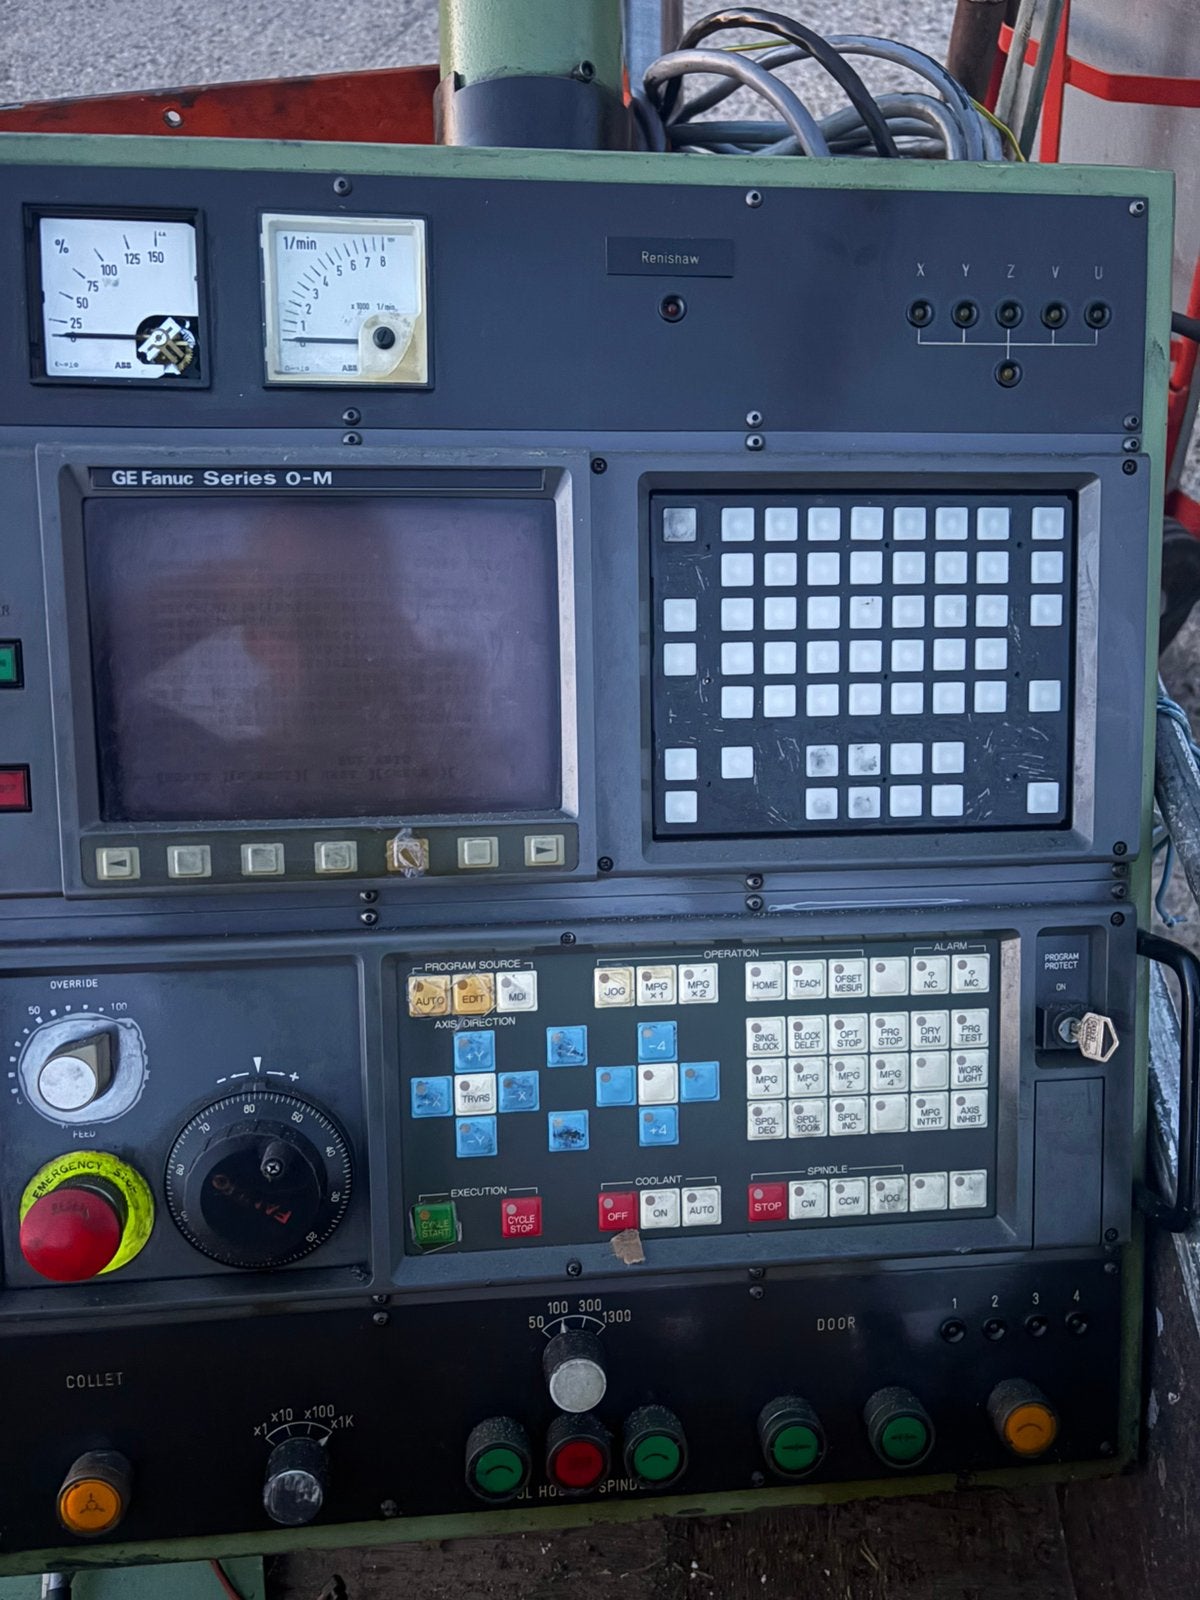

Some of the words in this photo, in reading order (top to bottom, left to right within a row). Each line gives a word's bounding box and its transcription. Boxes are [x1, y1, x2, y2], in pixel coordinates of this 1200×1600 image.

[55, 239, 69, 254] %
[283, 236, 318, 251] 1/min
[124, 252, 141, 266] 125
[147, 251, 165, 264] 150
[380, 257, 387, 267] 8
[641, 250, 701, 265] Renishaw
[350, 260, 357, 271] 6
[365, 257, 371, 269] 7
[100, 263, 118, 277] 100
[336, 265, 343, 276] 5
[916, 264, 925, 277] X
[962, 264, 970, 278] Y
[1007, 265, 1015, 278] Z
[1052, 266, 1060, 279] V
[1095, 267, 1103, 280] U
[86, 280, 99, 293] 75
[322, 277, 329, 288] 4
[312, 289, 320, 300] 3
[76, 296, 88, 310] 50
[305, 304, 312, 315] 2
[70, 316, 83, 330] 25
[301, 321, 306, 332] 1
[112, 470, 138, 486] GE
[141, 470, 194, 486] Fanuc
[203, 470, 277, 486] Series
[934, 942, 968, 951] ALARM
[704, 949, 759, 959] OPERATION
[1045, 952, 1079, 961] PROGRAM
[425, 962, 476, 971] PROGRAM
[479, 960, 521, 970] SOURCE
[1045, 961, 1078, 970] PROTECT
[835, 974, 861, 983] OFSET
[964, 978, 979, 987] MC
[50, 979, 98, 990] OVERRIDE
[645, 982, 668, 991] MPG
[688, 980, 709, 989] MPG
[752, 980, 778, 990] HOME
[794, 979, 821, 989] TEACH
[835, 983, 863, 993] MESUR
[923, 979, 938, 989] NC
[1056, 983, 1066, 991] ON
[508, 992, 526, 1002] MDI
[604, 987, 625, 997] JOG
[416, 996, 444, 1006] AUTO
[462, 994, 484, 1004] EDIT
[28, 1006, 41, 1015] 50
[111, 1002, 128, 1012] 100
[435, 1019, 457, 1030] AXIS
[463, 1017, 516, 1028] DIRECTION
[840, 1029, 858, 1039] OPT
[880, 1028, 899, 1037] PRG
[920, 1026, 941, 1035] DRY
[962, 1024, 981, 1034] PRG
[754, 1033, 778, 1042] SINGL
[794, 1031, 821, 1041] BLOCK
[878, 1036, 903, 1046] STOP
[921, 1034, 941, 1044] RUN
[959, 1033, 982, 1042] TEST
[649, 1041, 666, 1051] -4
[752, 1041, 780, 1052] BLOCK
[794, 1040, 820, 1050] DELET
[837, 1038, 862, 1048] STOP
[466, 1051, 484, 1061] +Y
[880, 1069, 902, 1079] MPG
[958, 1065, 983, 1075] WORK
[755, 1075, 777, 1085] MPG
[797, 1073, 819, 1083] MPG
[838, 1071, 860, 1081] MPG
[957, 1074, 983, 1083] LIGHT
[763, 1084, 770, 1092] X
[805, 1082, 812, 1091] Y
[846, 1080, 853, 1089] Z
[887, 1079, 895, 1087] 4
[461, 1093, 490, 1104] TRVRS
[920, 1108, 941, 1117] MPG
[960, 1106, 980, 1115] AXIS
[755, 1116, 779, 1126] SPDL
[796, 1114, 820, 1124] SPDL
[837, 1112, 862, 1122] SPDL
[917, 1116, 943, 1126] INTRT
[956, 1114, 982, 1124] INHBT
[198, 1123, 211, 1135] 70
[649, 1125, 667, 1135] +4
[757, 1125, 776, 1135] DEC
[797, 1123, 821, 1132] 100%
[841, 1121, 857, 1131] INC
[325, 1146, 336, 1158] 40
[807, 1165, 848, 1175] SPINDLE
[32, 1161, 103, 1199] EMERGENCY
[635, 1175, 682, 1185] COOLANT
[331, 1191, 341, 1203] 30
[450, 1186, 507, 1198] EXECUTION
[838, 1196, 860, 1206] CCW
[880, 1193, 900, 1203] JOG
[754, 1202, 782, 1212] STOP
[801, 1199, 816, 1208] CW
[653, 1208, 667, 1218] ON
[690, 1205, 714, 1216] AUTO
[508, 1215, 535, 1225] CYCLE
[607, 1211, 629, 1221] OFF
[421, 1219, 449, 1229] CYCLE
[510, 1224, 533, 1233] STOP
[305, 1231, 318, 1243] 20
[1033, 1293, 1039, 1305] 3
[1073, 1290, 1080, 1302] 4
[579, 1299, 602, 1312] 300
[952, 1298, 957, 1309] 1
[992, 1295, 998, 1308] 2
[547, 1301, 568, 1314] 100
[603, 1310, 631, 1323] 1300
[529, 1316, 544, 1329] 50
[817, 1316, 856, 1331] DOOR
[66, 1372, 123, 1389] COLLET
[271, 1408, 293, 1422] x10
[304, 1404, 335, 1419] x100
[254, 1423, 268, 1437] x1
[599, 1478, 646, 1494] SPIND
